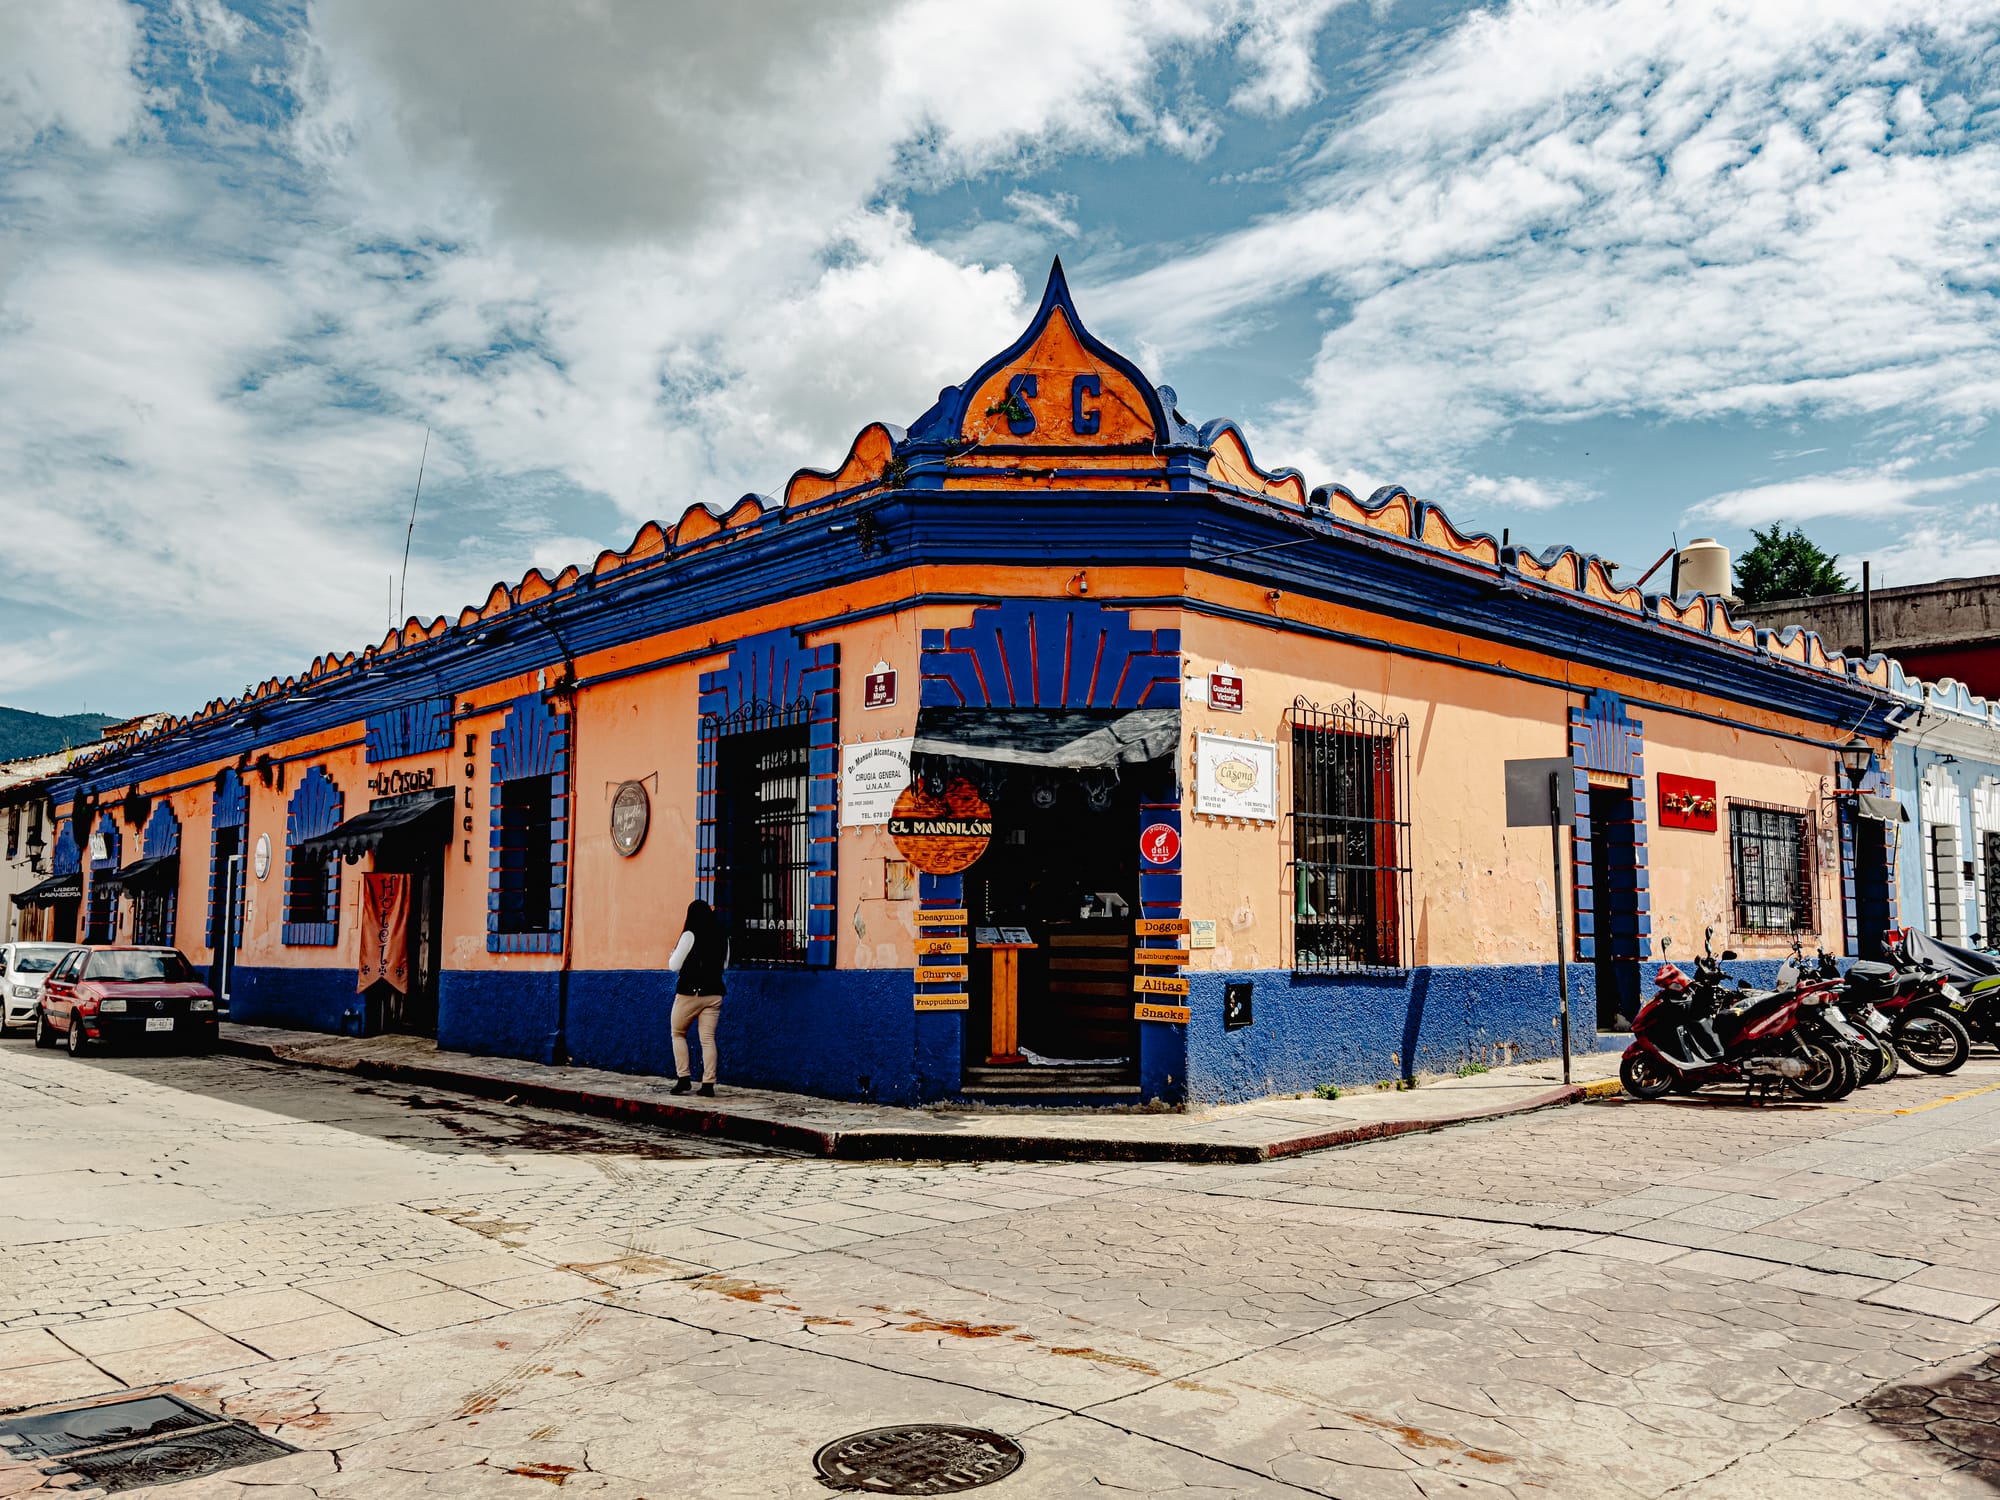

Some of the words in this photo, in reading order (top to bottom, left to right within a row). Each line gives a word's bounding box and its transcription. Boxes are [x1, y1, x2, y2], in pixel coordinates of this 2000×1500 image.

[1008, 373, 1038, 435] S
[854, 748, 873, 767] Manuel
[855, 772, 877, 782] CIRUGIA
[878, 769, 902, 780] GENERAL
[1220, 766, 1253, 783] Casona
[913, 819, 992, 835] MANDILÓN
[918, 913, 965, 922] Desayunos
[1144, 922, 1183, 933] Doggos
[929, 942, 952, 952] Café
[922, 970, 962, 979] Churros
[1142, 979, 1183, 992] Alitas
[916, 998, 968, 1007] Frappuchinos
[1141, 1007, 1184, 1020] Snacks
